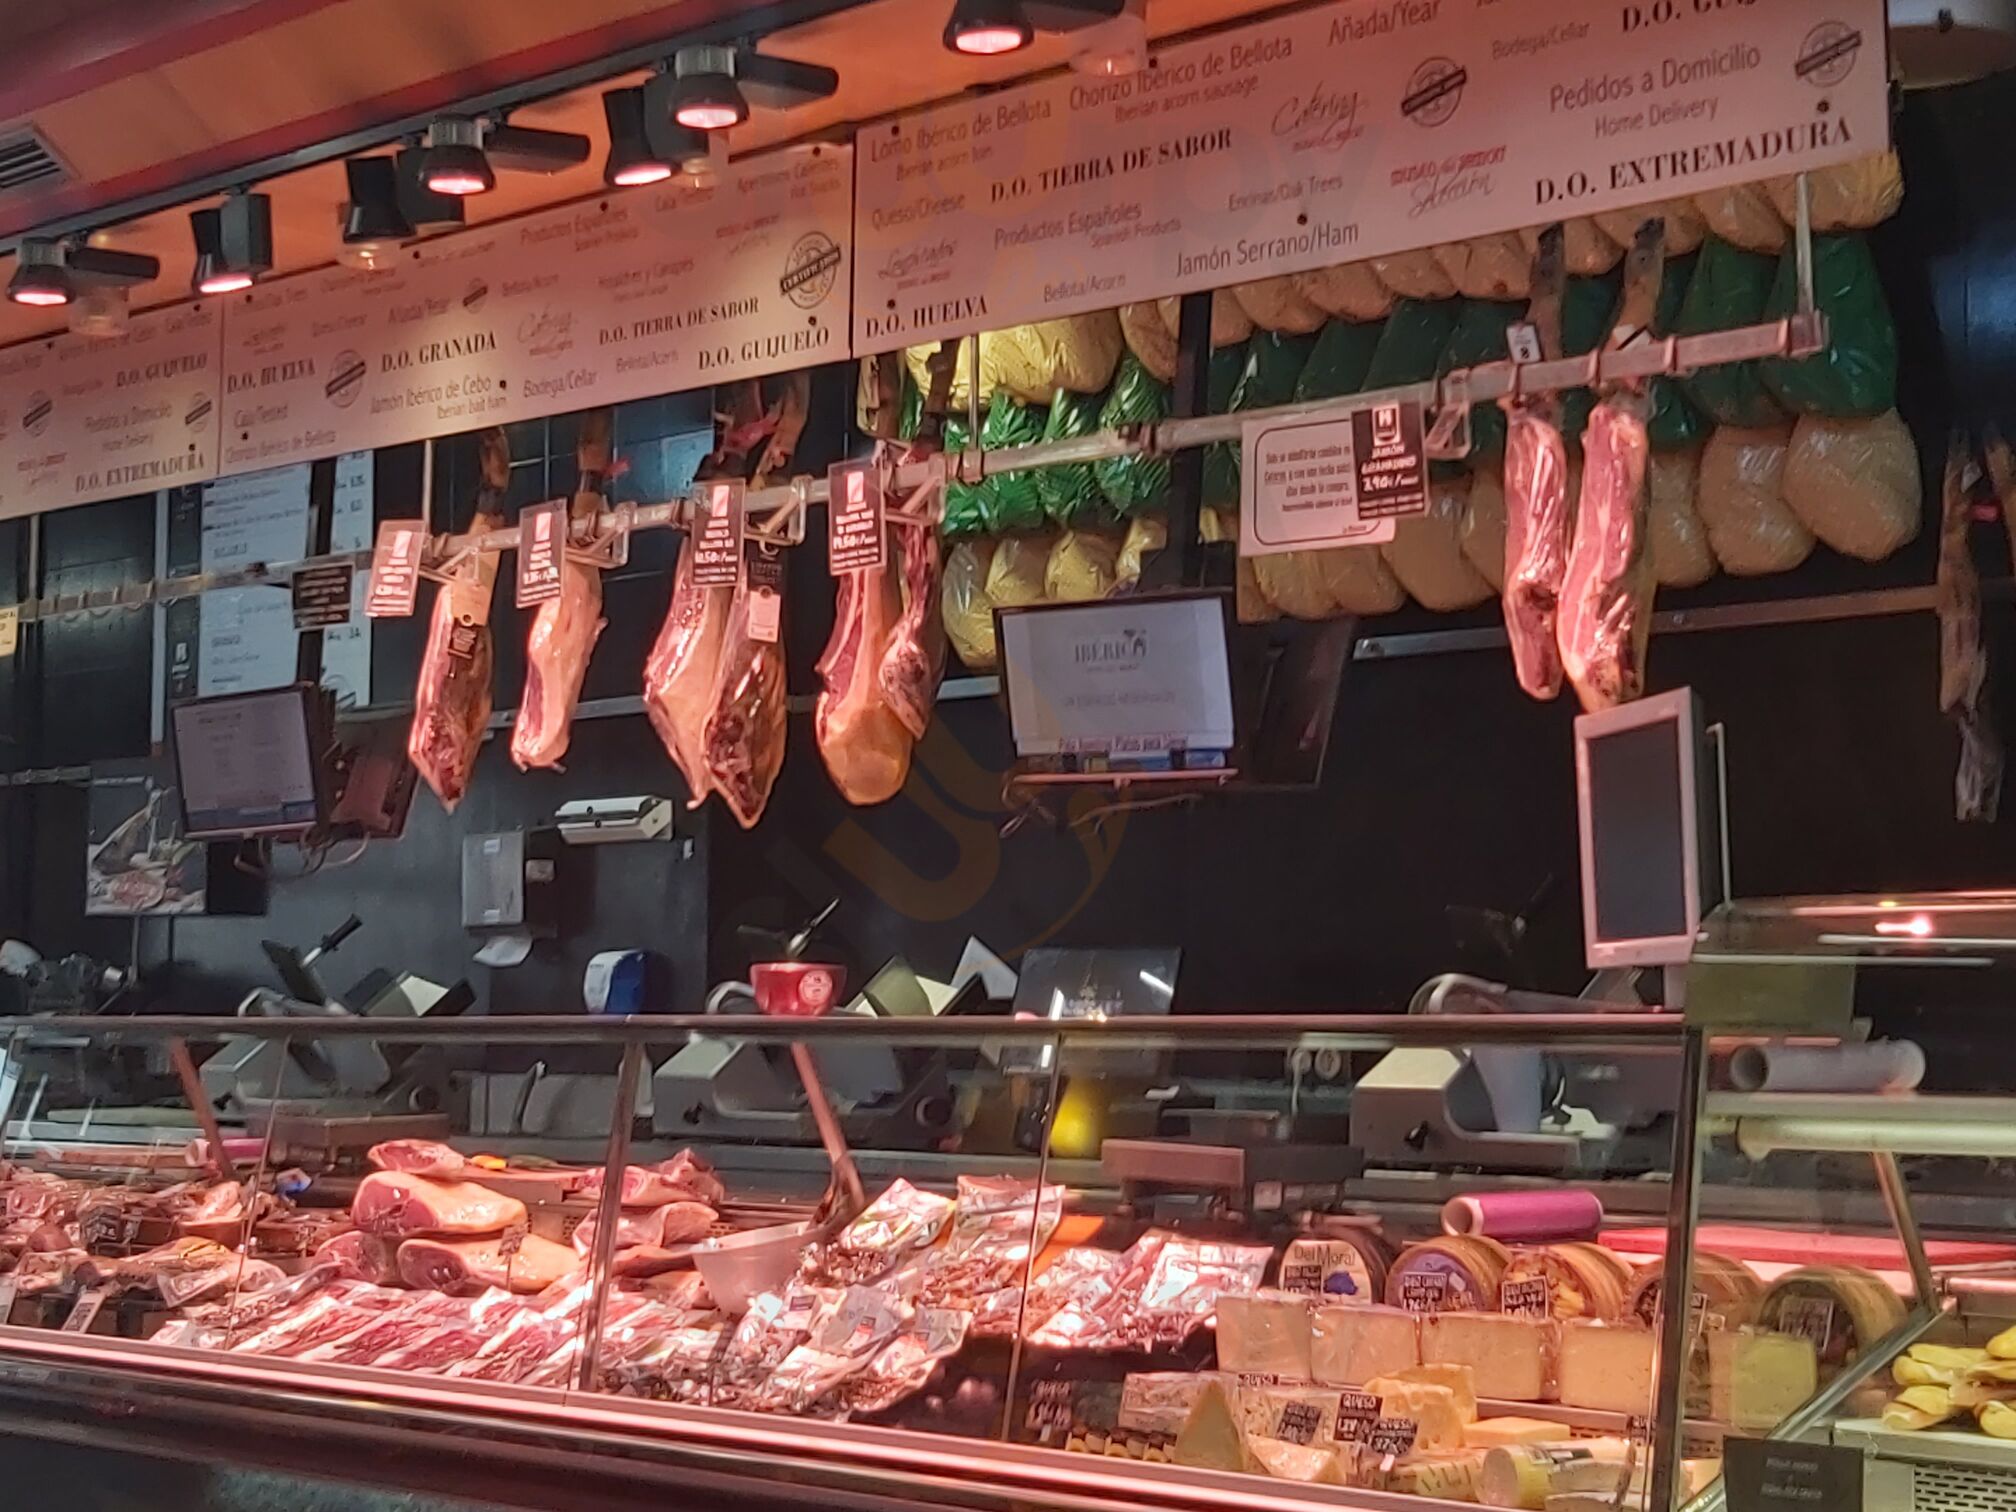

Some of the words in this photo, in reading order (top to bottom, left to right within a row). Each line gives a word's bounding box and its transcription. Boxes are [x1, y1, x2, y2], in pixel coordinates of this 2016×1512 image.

[1069, 78, 1132, 111] Chorizo
[1202, 53, 1224, 77] de
[1230, 37, 1293, 71] Bellota
[1551, 74, 1633, 113] Pedidos
[1641, 72, 1654, 92] a
[1662, 44, 1761, 90] Domicilio
[972, 108, 992, 129] de
[996, 99, 1051, 131] Bellota
[1595, 110, 1643, 138] Home
[1650, 96, 1718, 127] Delivery
[991, 181, 1032, 204] D.O.
[1039, 155, 1115, 191] TIERRA
[1123, 149, 1153, 173] DE
[1158, 127, 1232, 160] SABOR
[1535, 172, 1597, 205] D.O.
[1609, 116, 1852, 191] EXTREMADURA
[1176, 246, 1231, 278] Jamón
[1237, 221, 1359, 263] Serrano/Ham
[600, 325, 628, 346] D.O.
[633, 310, 682, 340] TIERRA
[687, 305, 706, 326] DE
[711, 296, 759, 323] SABOR
[866, 315, 905, 339] D.O.
[913, 295, 987, 329] HUELVA
[381, 353, 413, 374] D.O.
[419, 331, 496, 365] GRANADA
[699, 348, 736, 371] D.O.
[741, 326, 829, 362] GUIJUELO
[445, 381, 460, 398] de
[462, 374, 492, 398] Cebo
